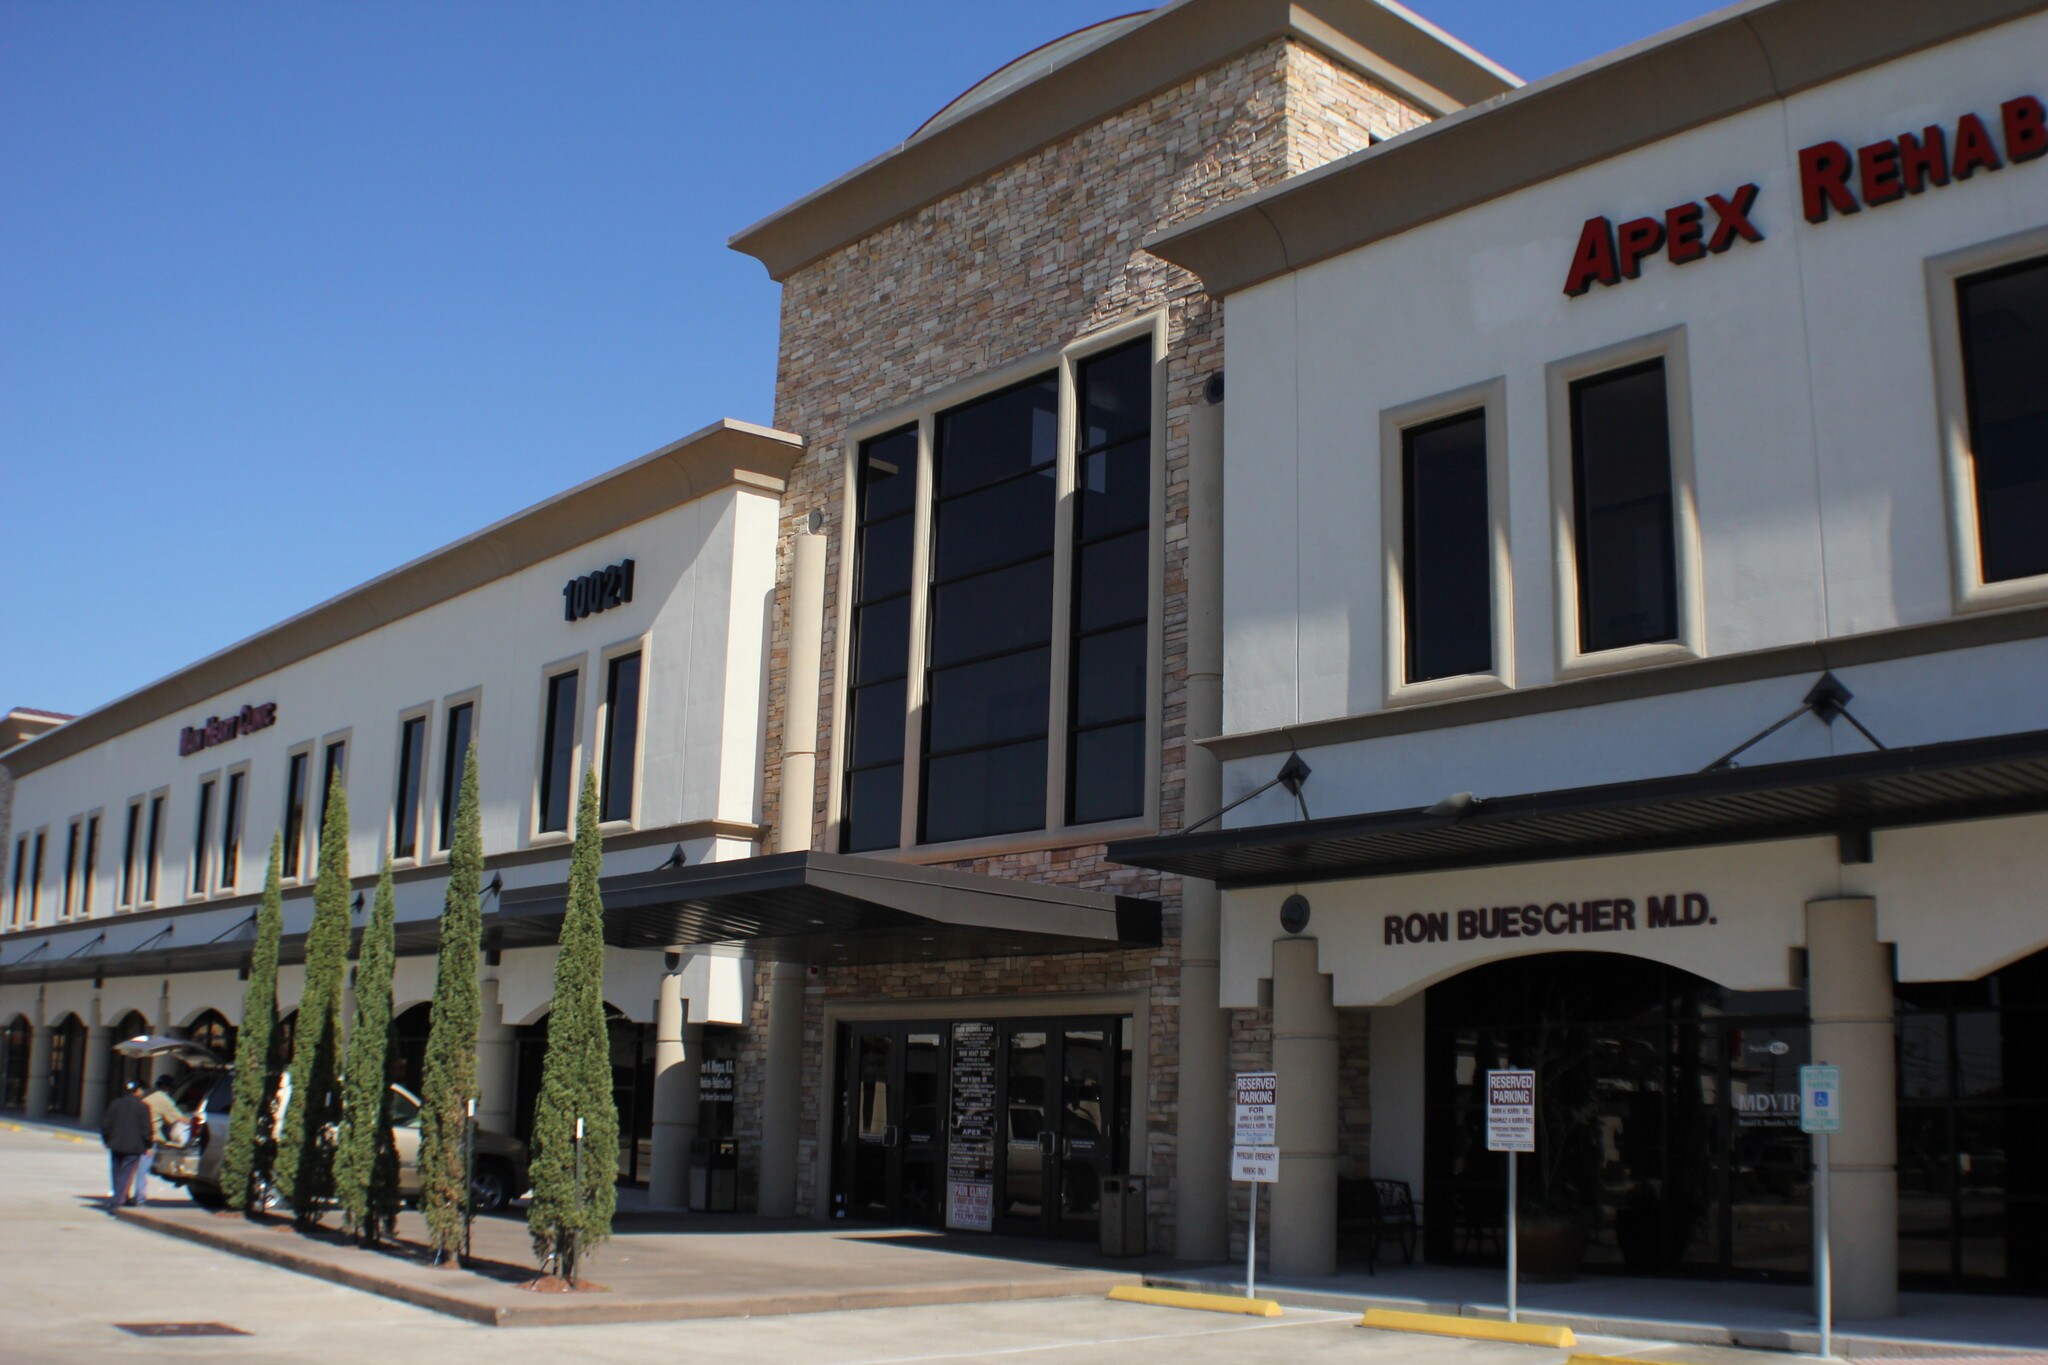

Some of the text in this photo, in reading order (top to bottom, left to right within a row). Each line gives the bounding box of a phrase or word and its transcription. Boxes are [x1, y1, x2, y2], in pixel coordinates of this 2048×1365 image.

[1563, 95, 2048, 298] APEX REHAB
[563, 558, 635, 622] 10021
[1383, 892, 1718, 946] RON BUESCHER M.D.
[1237, 1077, 1276, 1091] RESERVED
[1490, 1075, 1533, 1089] RESERVED
[1239, 1090, 1273, 1104] PARKING
[1493, 1089, 1530, 1104] PARKING
[1739, 1094, 1801, 1112] MDVIP
[969, 1185, 989, 1199] CLINIC
